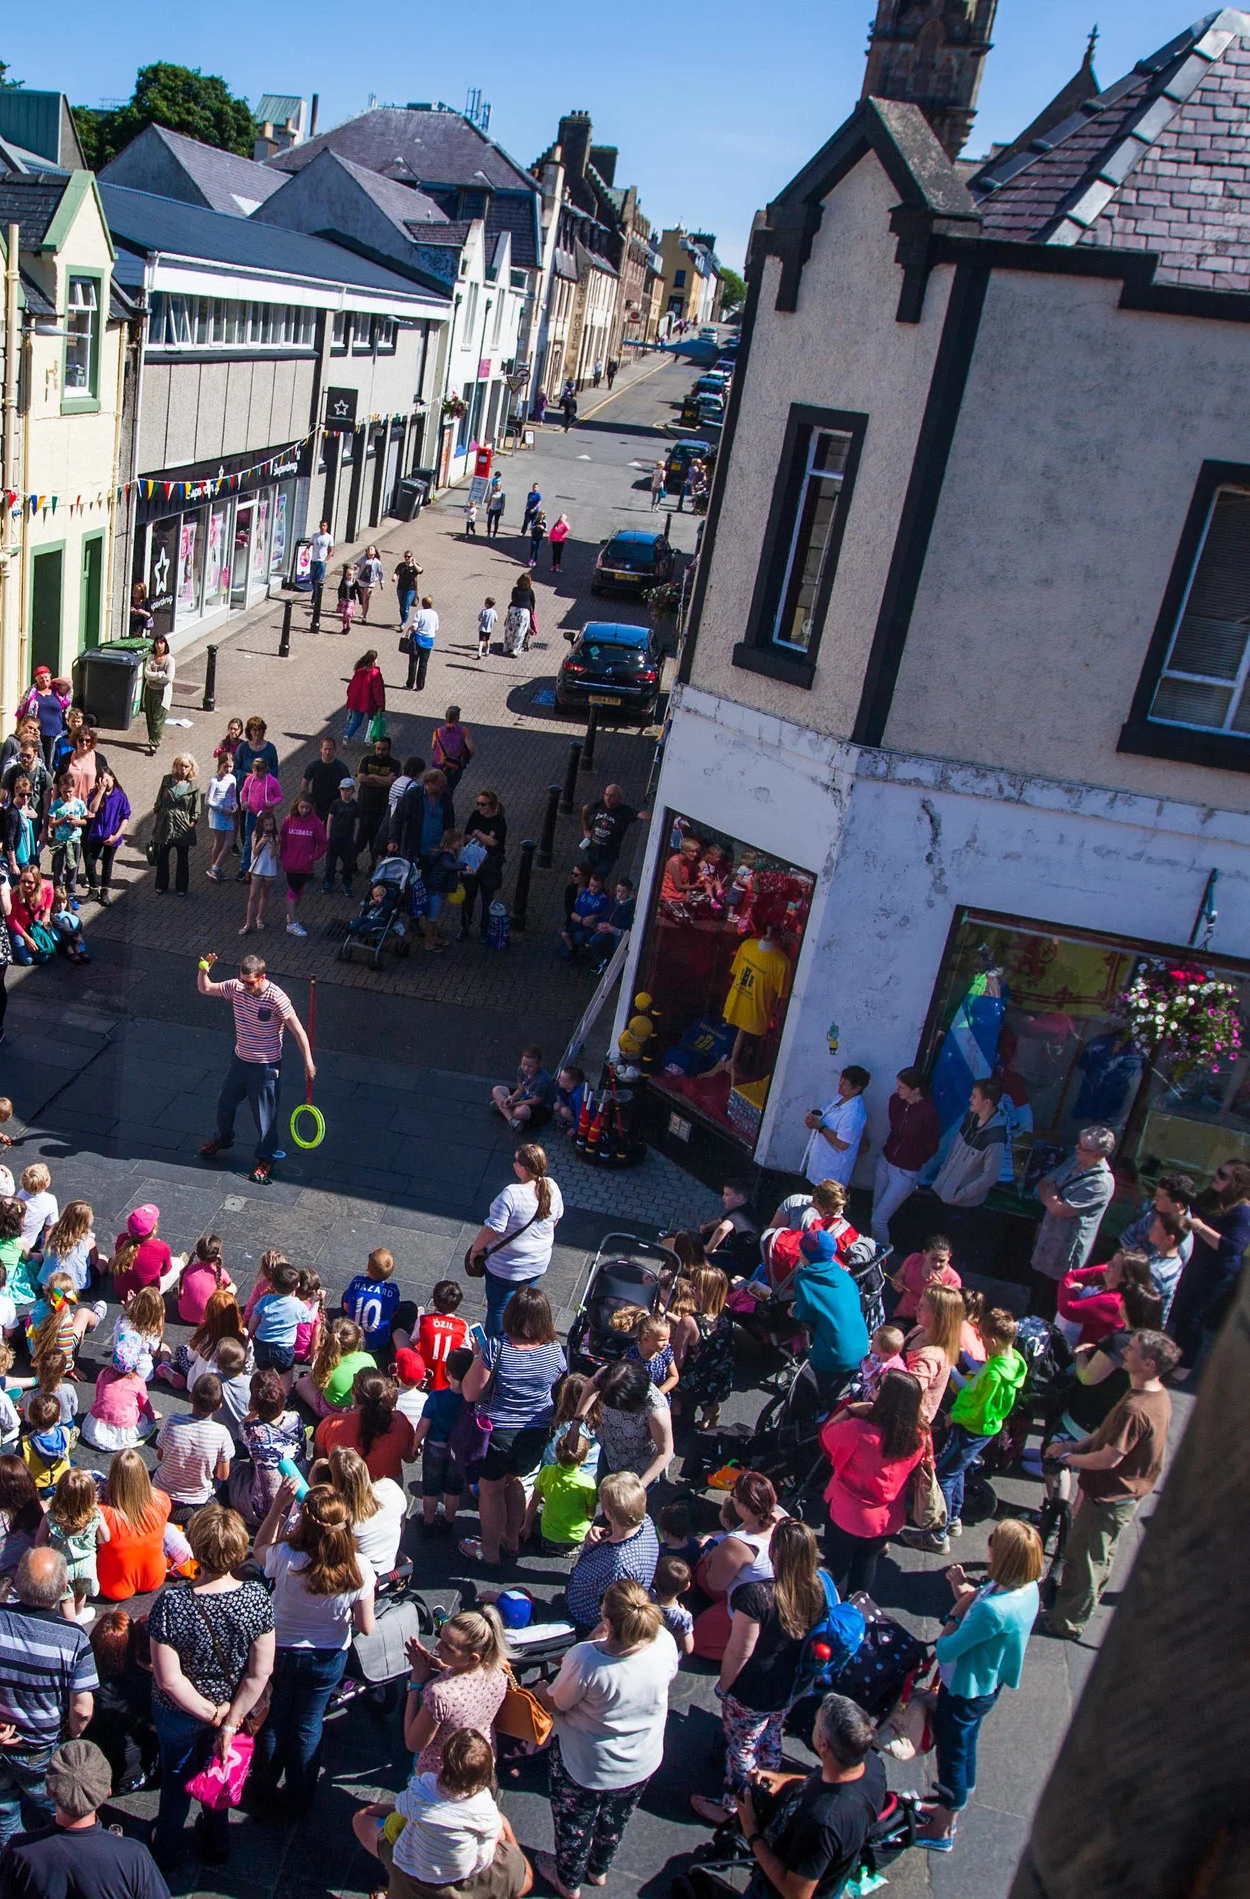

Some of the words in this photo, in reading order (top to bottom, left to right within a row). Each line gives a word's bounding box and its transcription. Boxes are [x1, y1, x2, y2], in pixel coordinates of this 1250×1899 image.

[354, 1282, 394, 1298] HAZARD
[354, 1296, 383, 1333] 10
[432, 1318, 454, 1331] ÖZIL
[432, 1333, 453, 1362] 11
